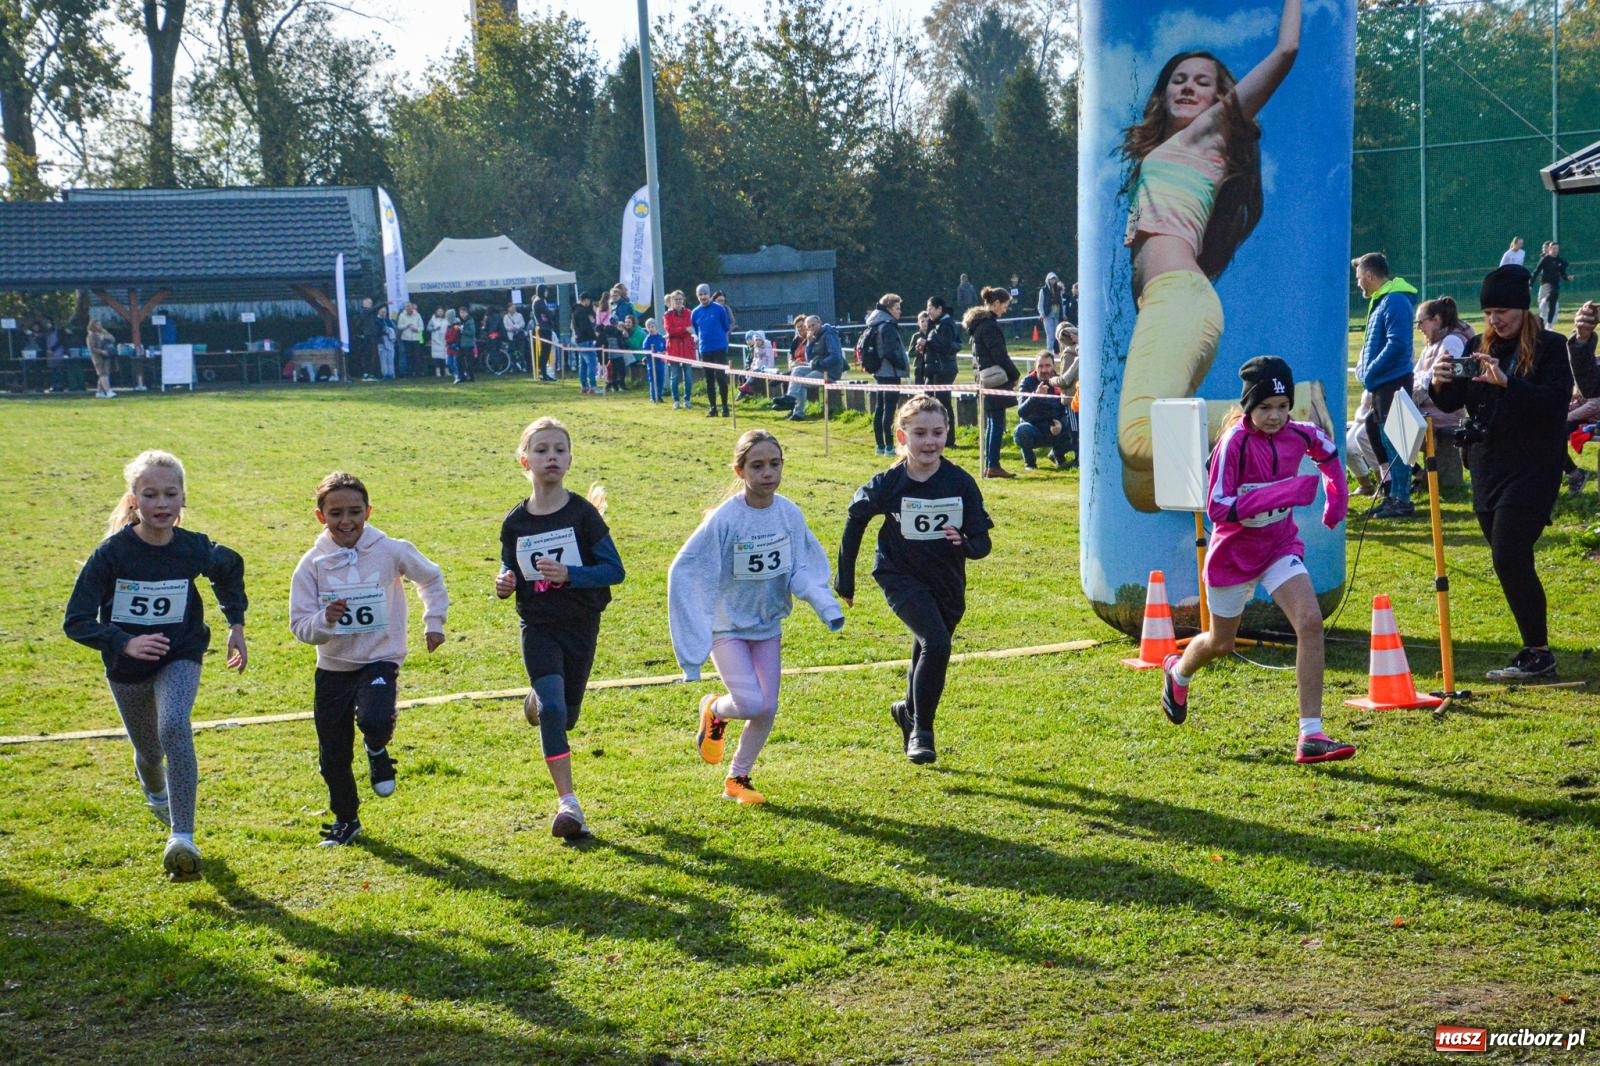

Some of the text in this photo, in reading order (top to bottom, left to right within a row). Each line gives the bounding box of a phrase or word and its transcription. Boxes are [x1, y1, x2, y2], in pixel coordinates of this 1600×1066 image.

[1272, 378, 1285, 393] LA
[914, 513, 949, 533] 62
[748, 550, 781, 573] 53
[129, 596, 171, 617] 59
[338, 606, 374, 626] 66
